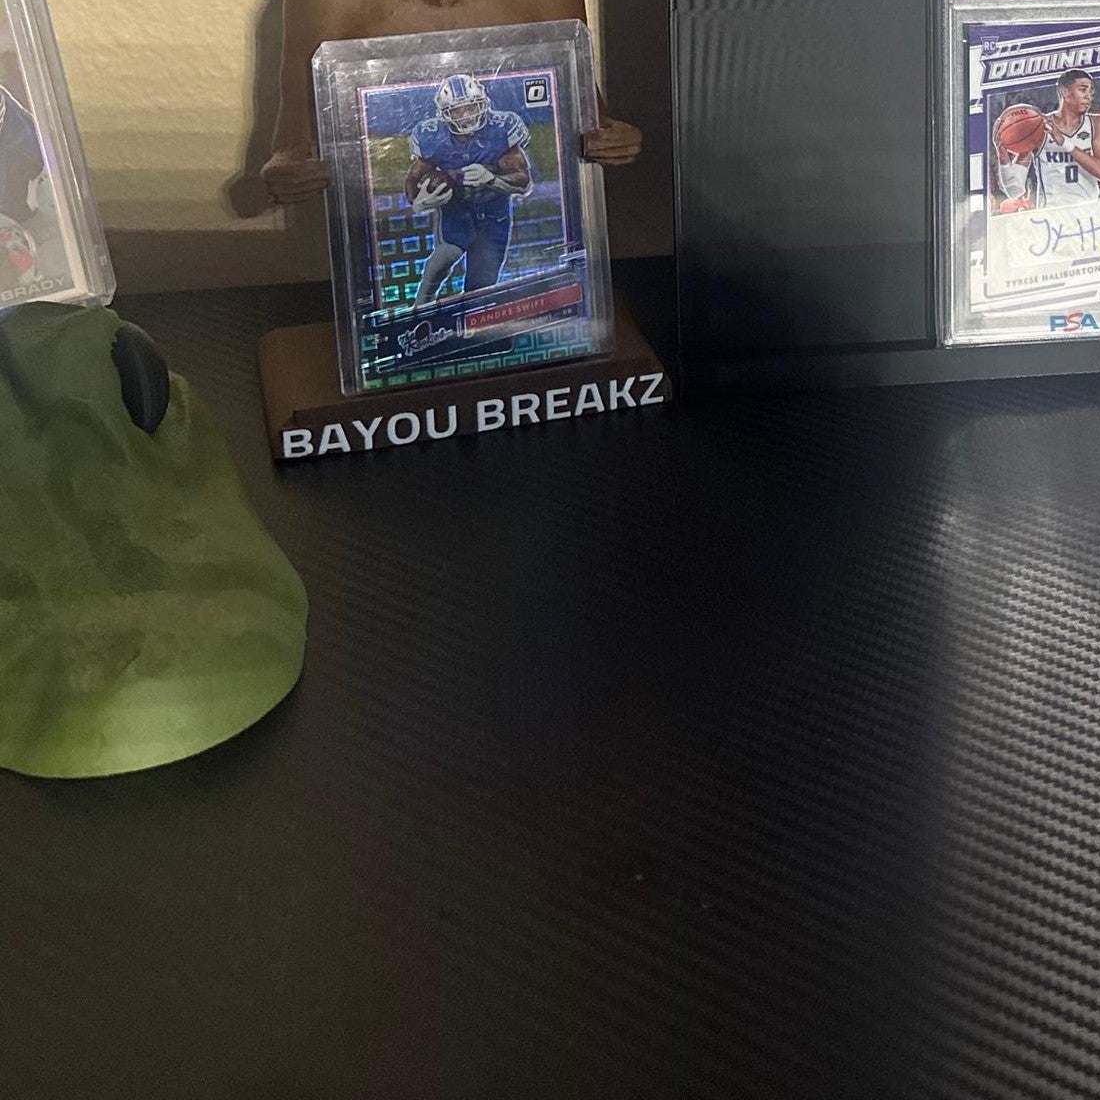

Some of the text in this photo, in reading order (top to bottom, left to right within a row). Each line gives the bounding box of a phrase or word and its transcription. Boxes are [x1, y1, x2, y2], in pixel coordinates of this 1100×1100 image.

[984, 42, 996, 51] RC
[1, 276, 65, 301] BRADY
[1006, 275, 1039, 288] TYRESE
[1050, 311, 1100, 332] PSA
[282, 372, 664, 458] BAYOU BREAKZ
